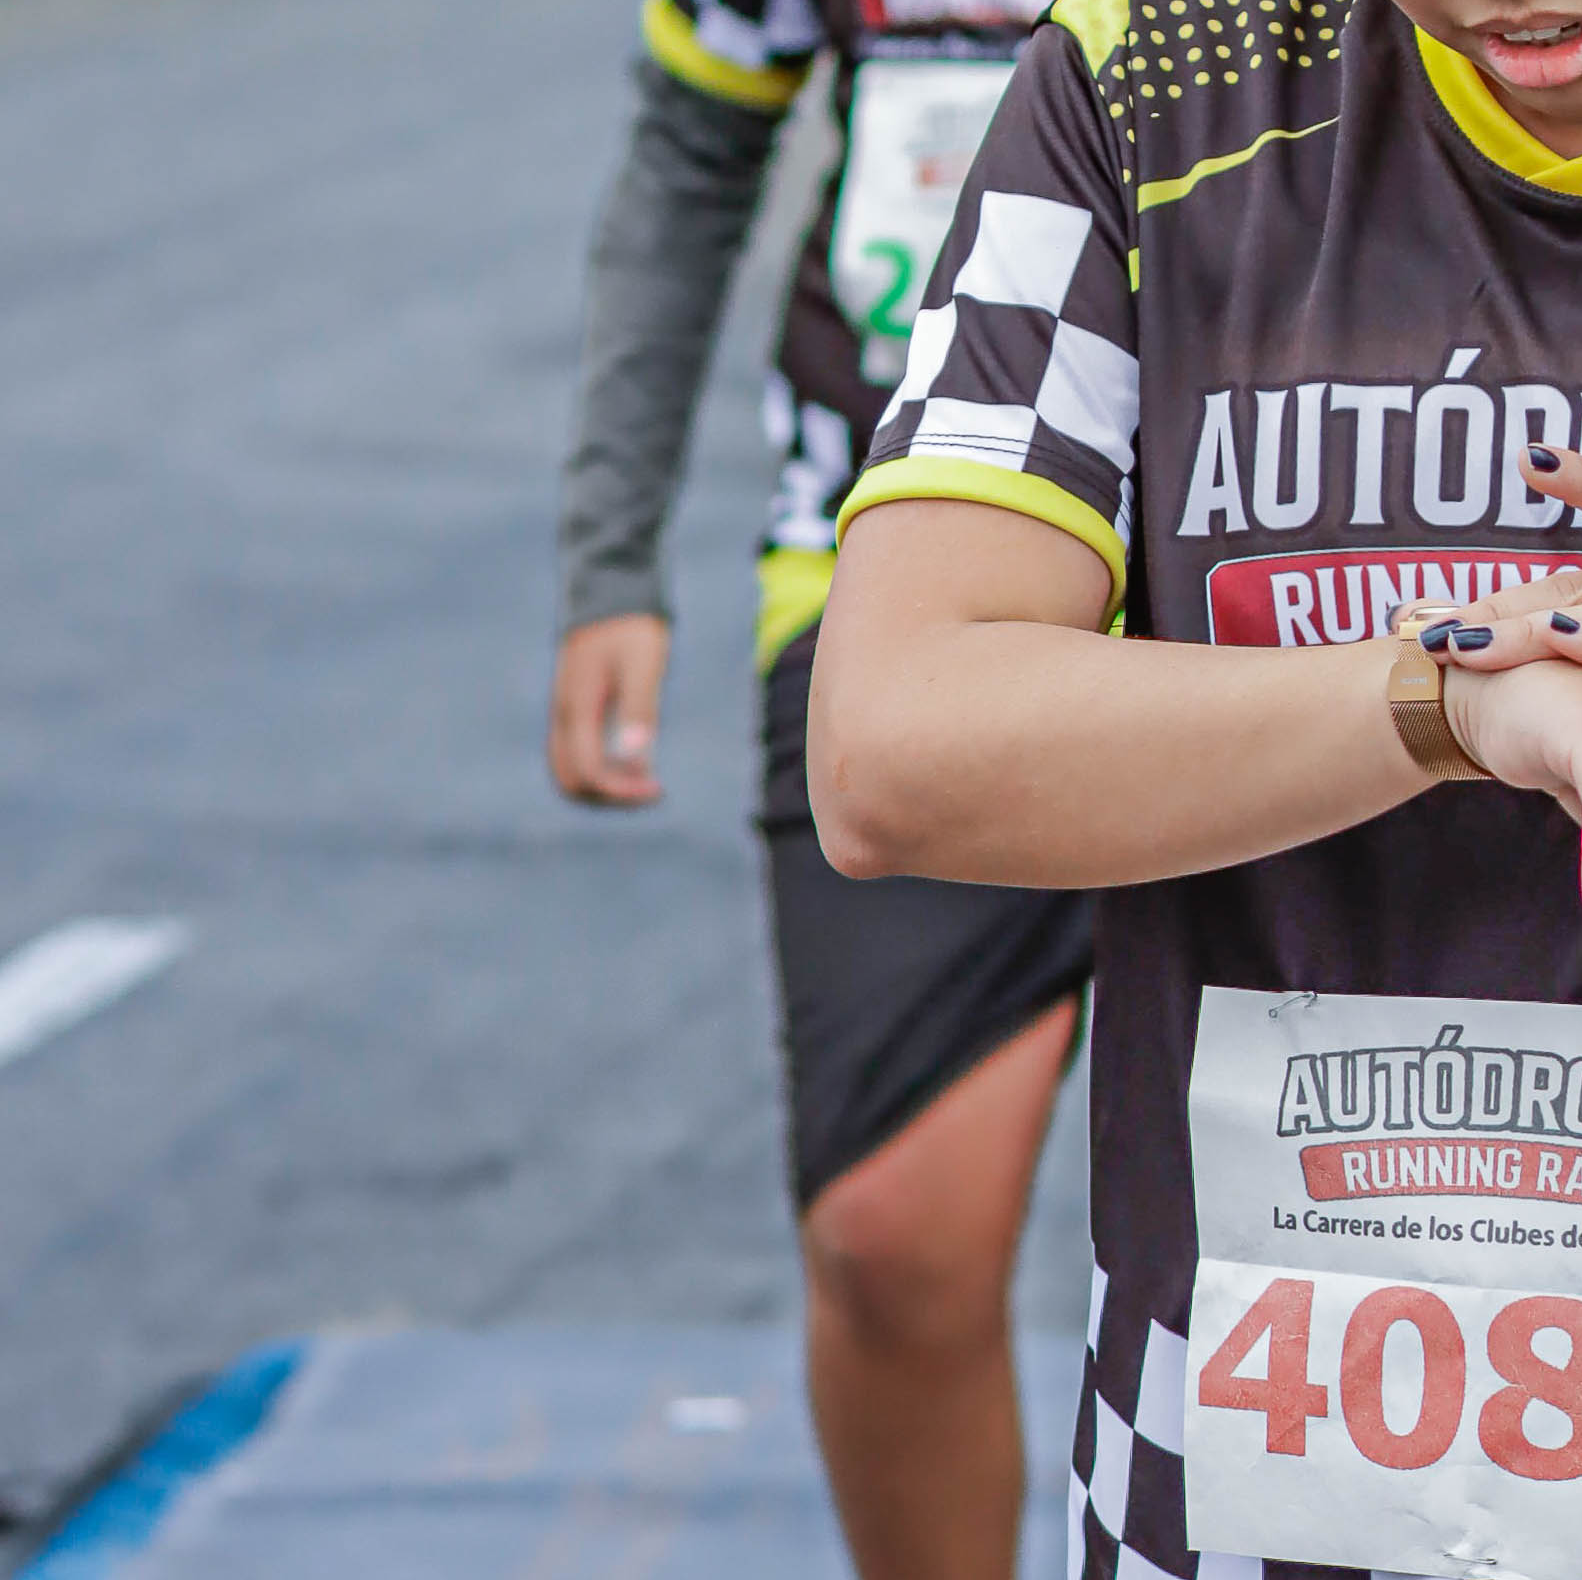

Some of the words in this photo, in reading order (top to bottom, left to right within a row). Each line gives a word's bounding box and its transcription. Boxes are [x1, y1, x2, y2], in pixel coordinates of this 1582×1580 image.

[1270, 562, 1578, 648] RUNNI
[1341, 1144, 1523, 1193] RUNNING
[1273, 1206, 1297, 1231] La
[1303, 1209, 1385, 1239] Carrera
[1388, 1214, 1423, 1241] de
[1429, 1215, 1464, 1243] los
[1470, 1218, 1555, 1248] Clubes
